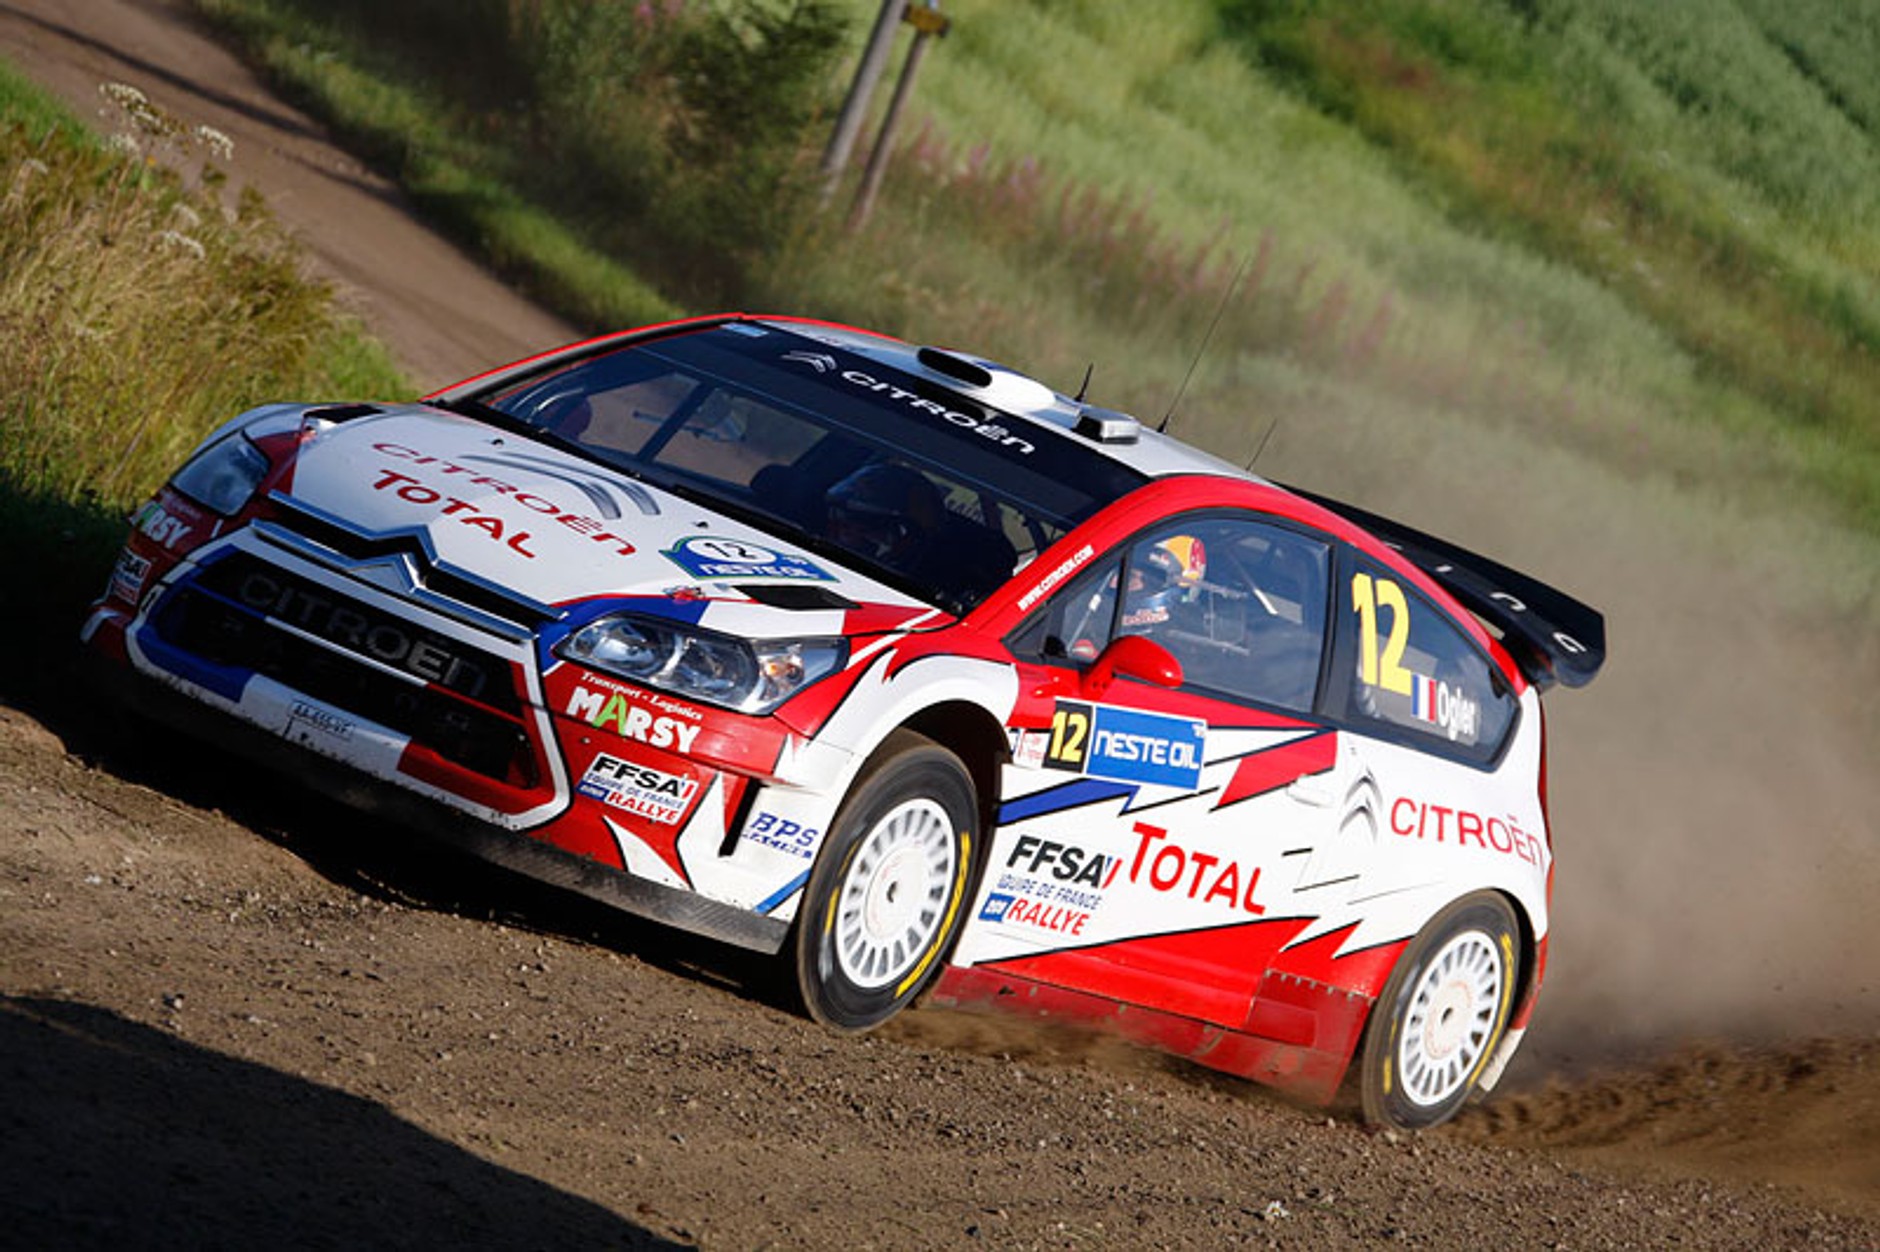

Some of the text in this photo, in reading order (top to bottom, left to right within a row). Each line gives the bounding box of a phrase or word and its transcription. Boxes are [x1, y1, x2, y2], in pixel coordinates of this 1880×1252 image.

[373, 469, 535, 559] TOTAL
[704, 542, 757, 559] 12
[1352, 572, 1411, 696] 12
[566, 686, 701, 753] MARSY
[1050, 709, 1088, 763] 12
[1093, 730, 1169, 765] NESTE
[1168, 741, 1200, 770] OIL
[593, 756, 680, 798] FFSA
[608, 791, 680, 822] RALLYE
[750, 811, 818, 847] BPS
[1006, 834, 1106, 889] FFSA
[1129, 821, 1266, 916] TOTAL
[1007, 898, 1091, 936] RALLYE
[1036, 881, 1056, 900] DE
[1055, 886, 1103, 911] FRANCE
